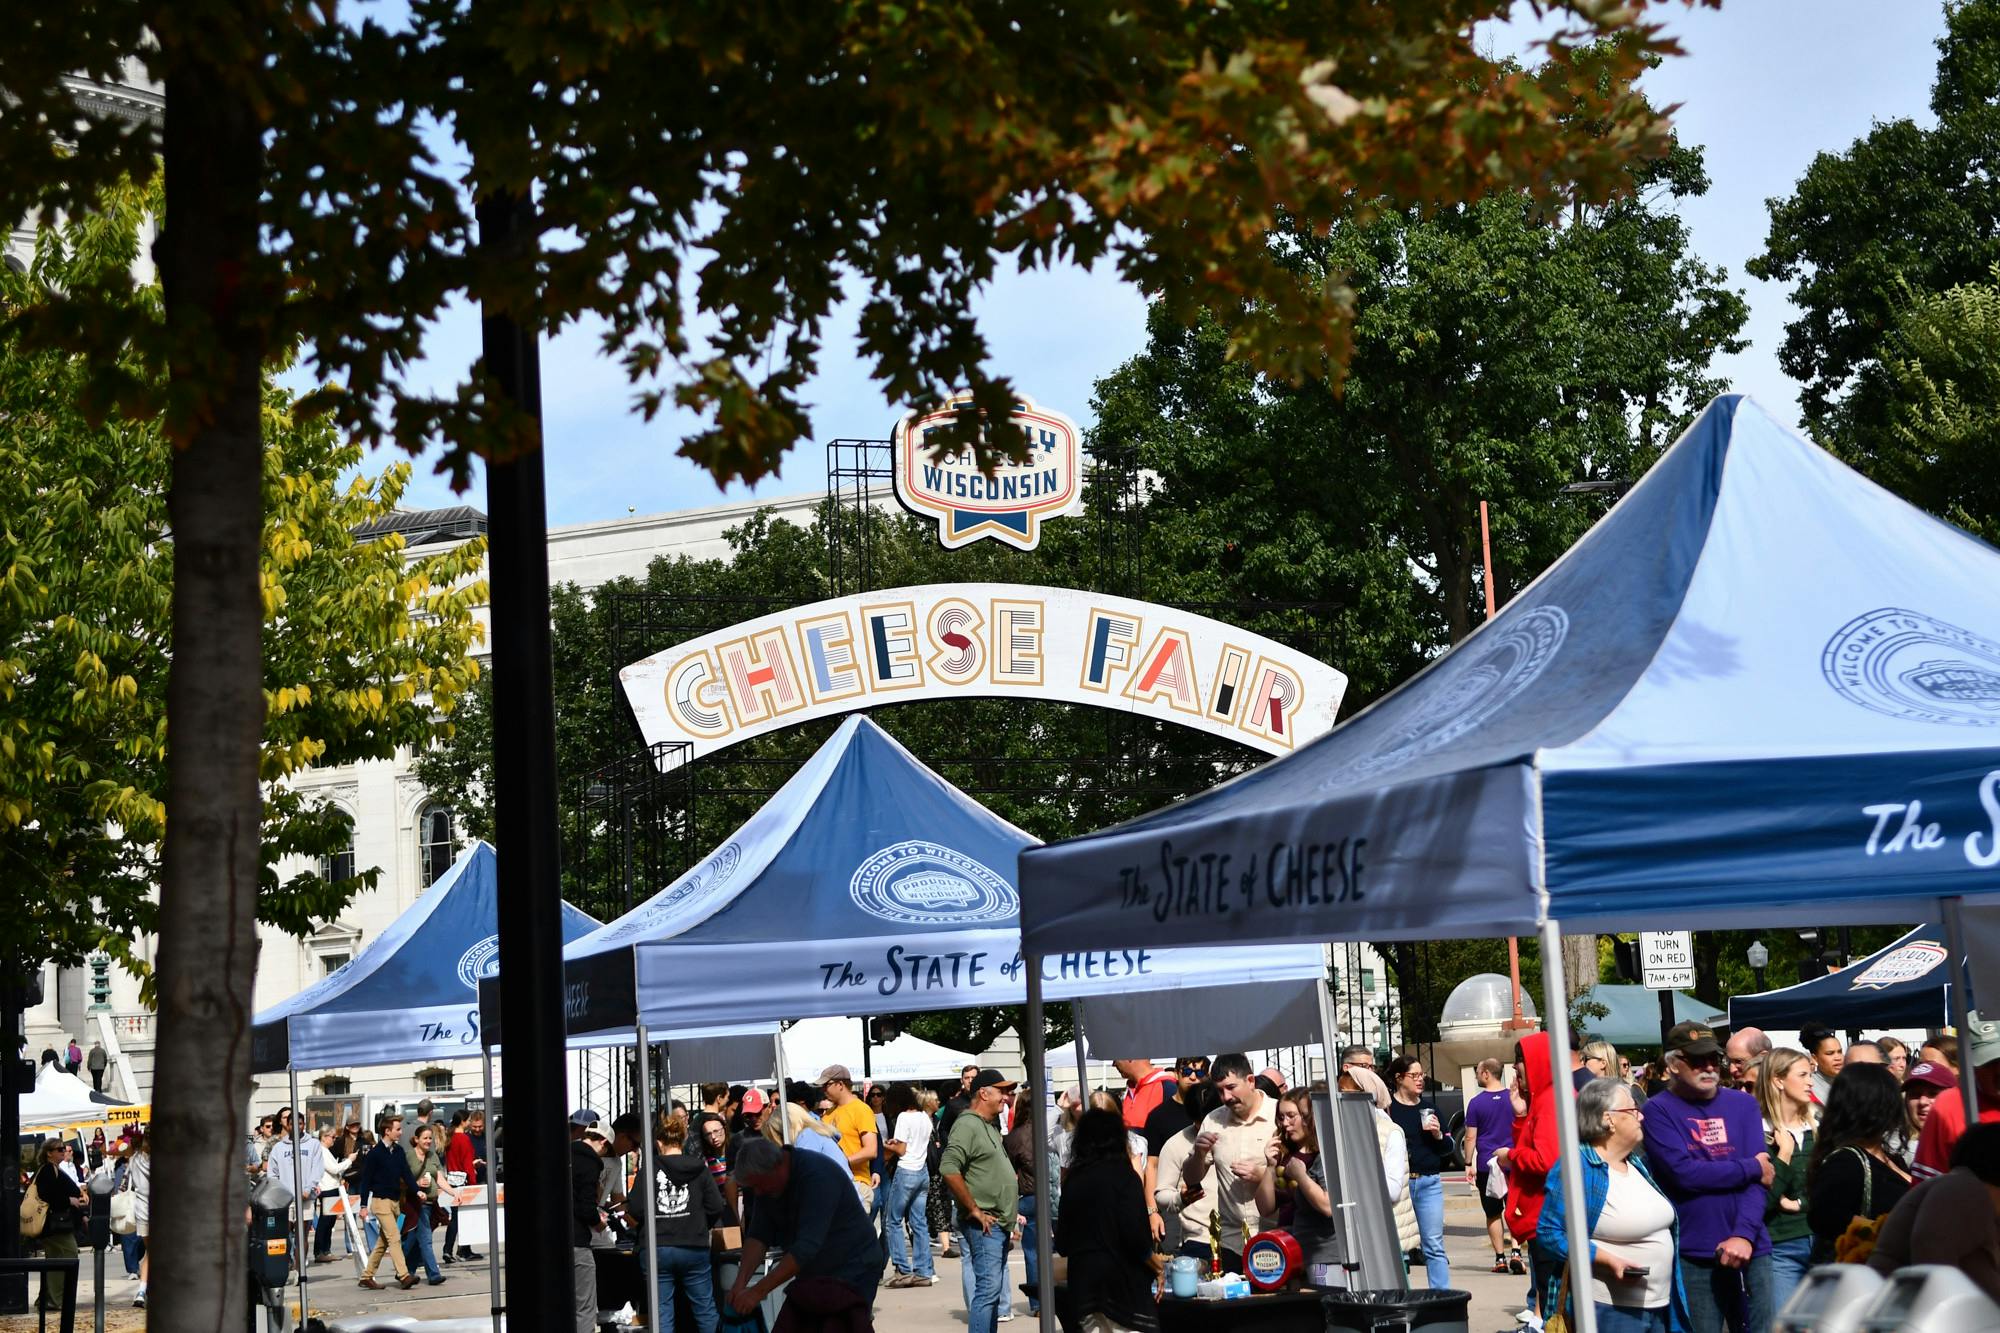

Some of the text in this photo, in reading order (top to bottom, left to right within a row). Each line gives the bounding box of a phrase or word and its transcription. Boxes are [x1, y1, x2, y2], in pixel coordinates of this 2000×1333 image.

[923, 464, 1057, 500] WISCONSIN
[664, 597, 1044, 739] CHEESE
[1080, 606, 1304, 750] FAIR
[1840, 626, 1886, 686] WELCOME
[1886, 618, 1919, 630] TO
[1862, 799, 1946, 856] The
[860, 847, 1000, 893] WELCOME TO WISCONSIN
[1120, 837, 1368, 923] The STATE of CHEESE
[1649, 952, 1687, 964] ON RED
[1653, 939, 1680, 950] TURN
[819, 960, 867, 990] The
[877, 944, 988, 996] STATE
[1000, 952, 1024, 982] of
[419, 1021, 452, 1042] The
